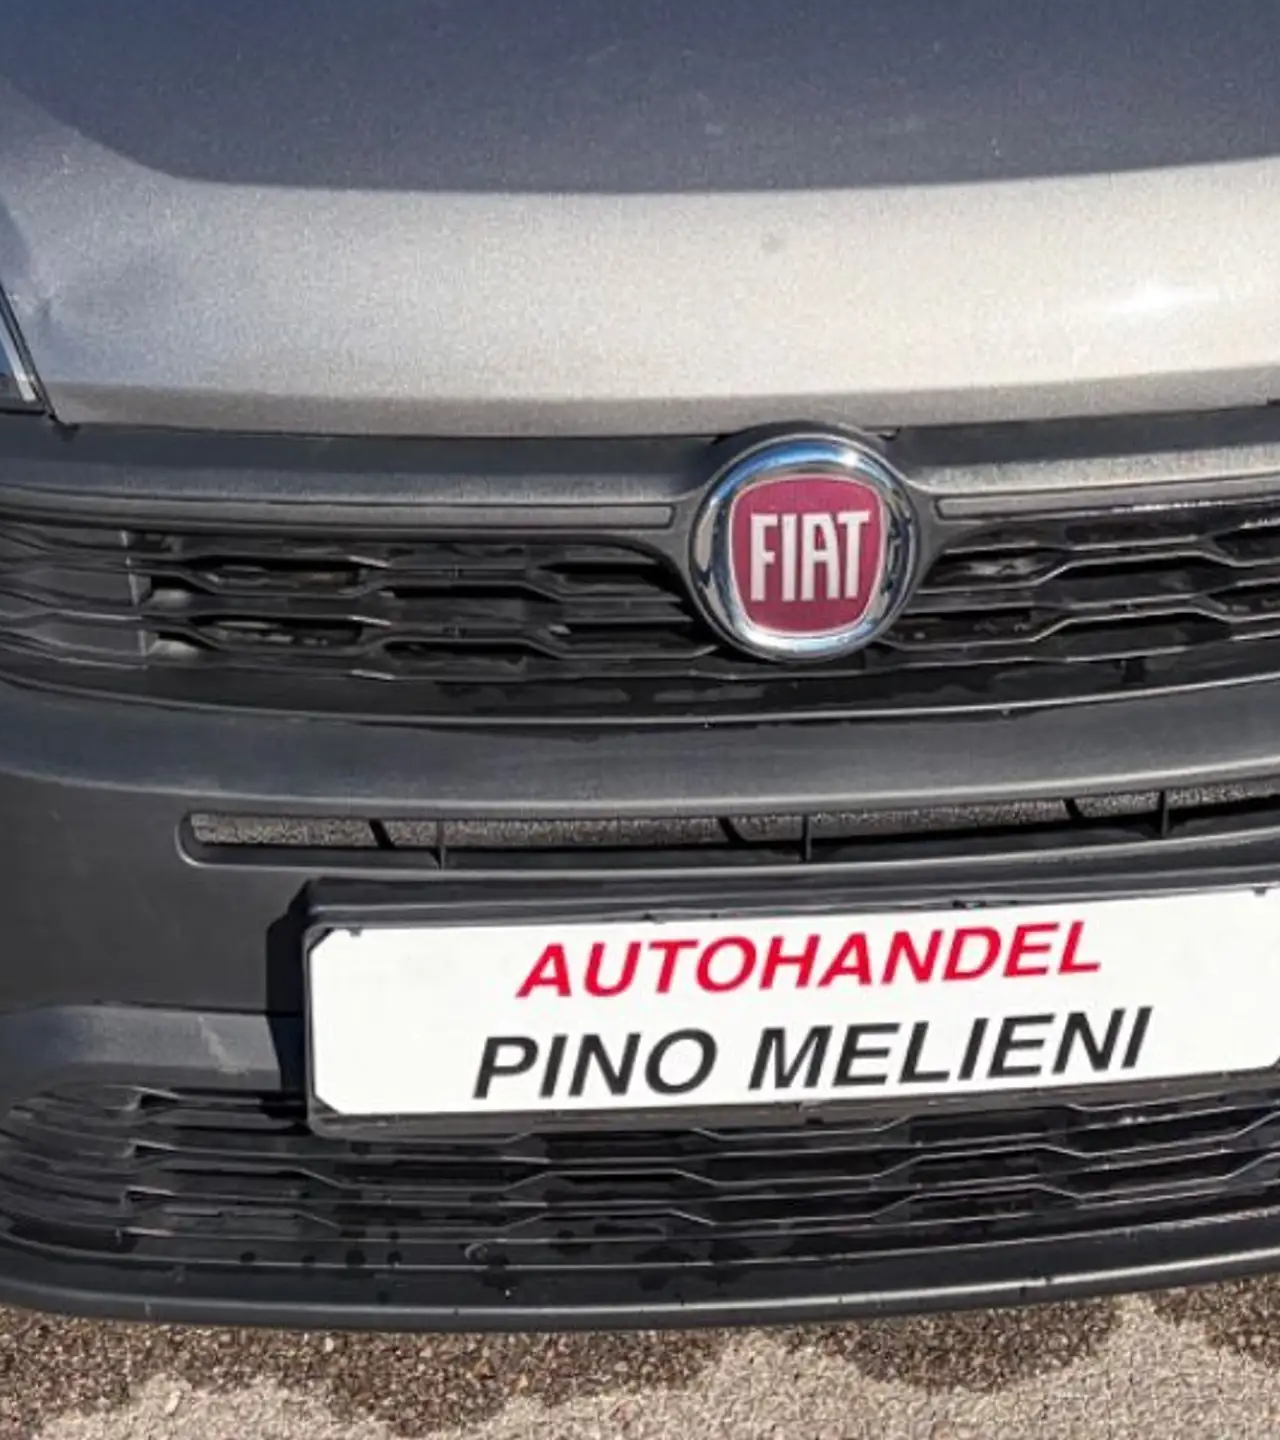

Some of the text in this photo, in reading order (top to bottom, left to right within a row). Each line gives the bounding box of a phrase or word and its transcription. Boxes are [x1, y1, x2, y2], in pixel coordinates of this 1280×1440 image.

[749, 511, 870, 602] FIAT
[516, 921, 1100, 998] AUTOHANDEL
[473, 1006, 1153, 1100] PINO MELIENI
